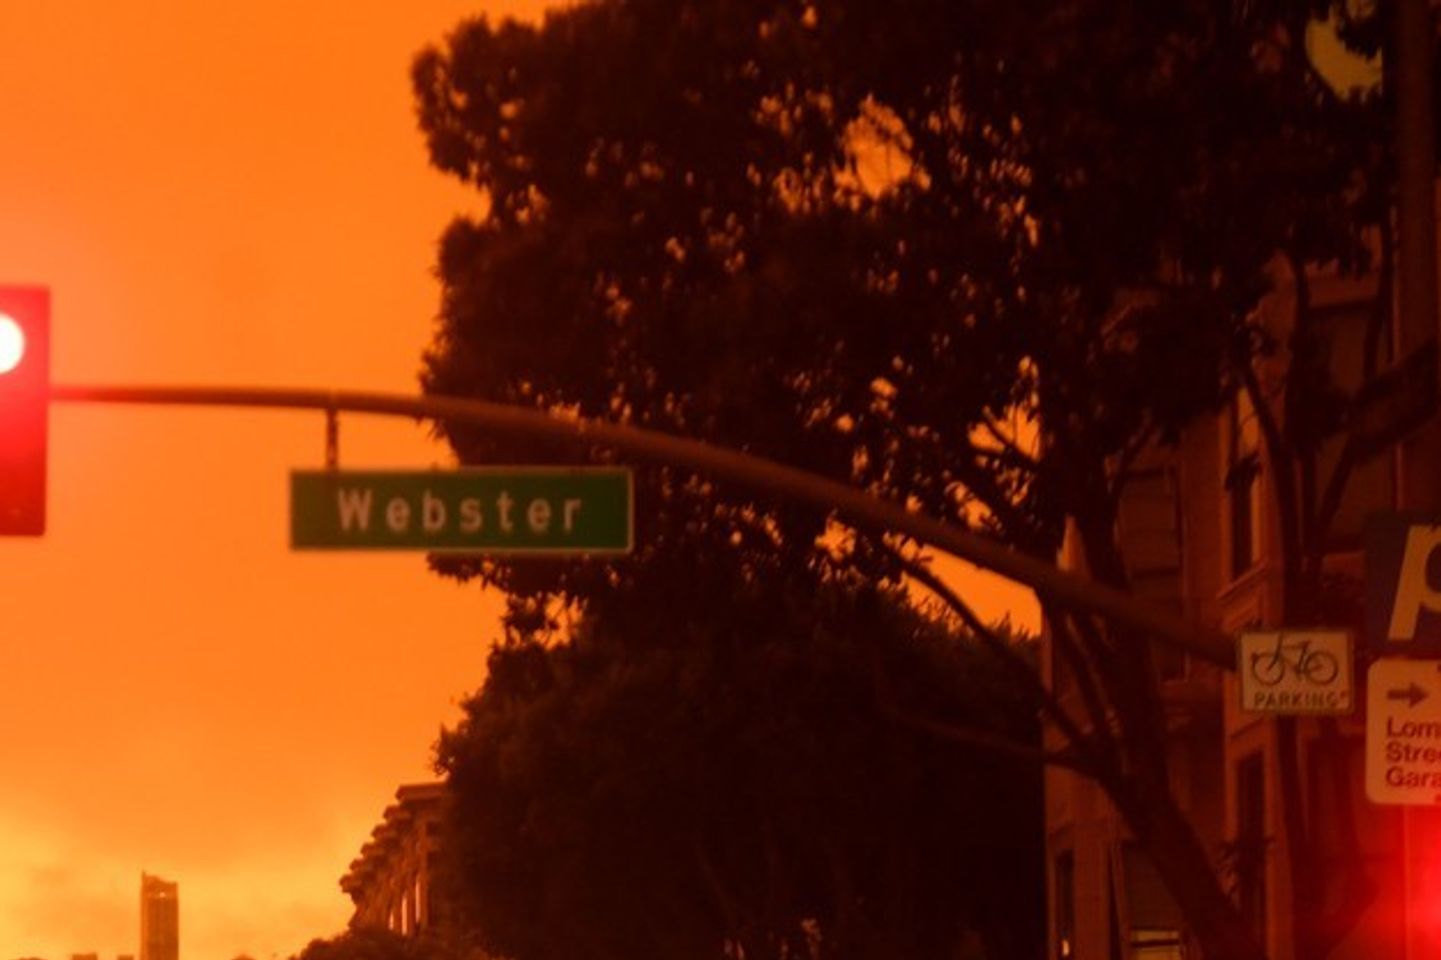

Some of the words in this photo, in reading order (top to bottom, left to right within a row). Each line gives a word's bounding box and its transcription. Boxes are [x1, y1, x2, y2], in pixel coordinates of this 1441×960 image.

[338, 489, 582, 533] Webster
[1253, 691, 1339, 708] PARKING
[1386, 741, 1441, 762] Stre
